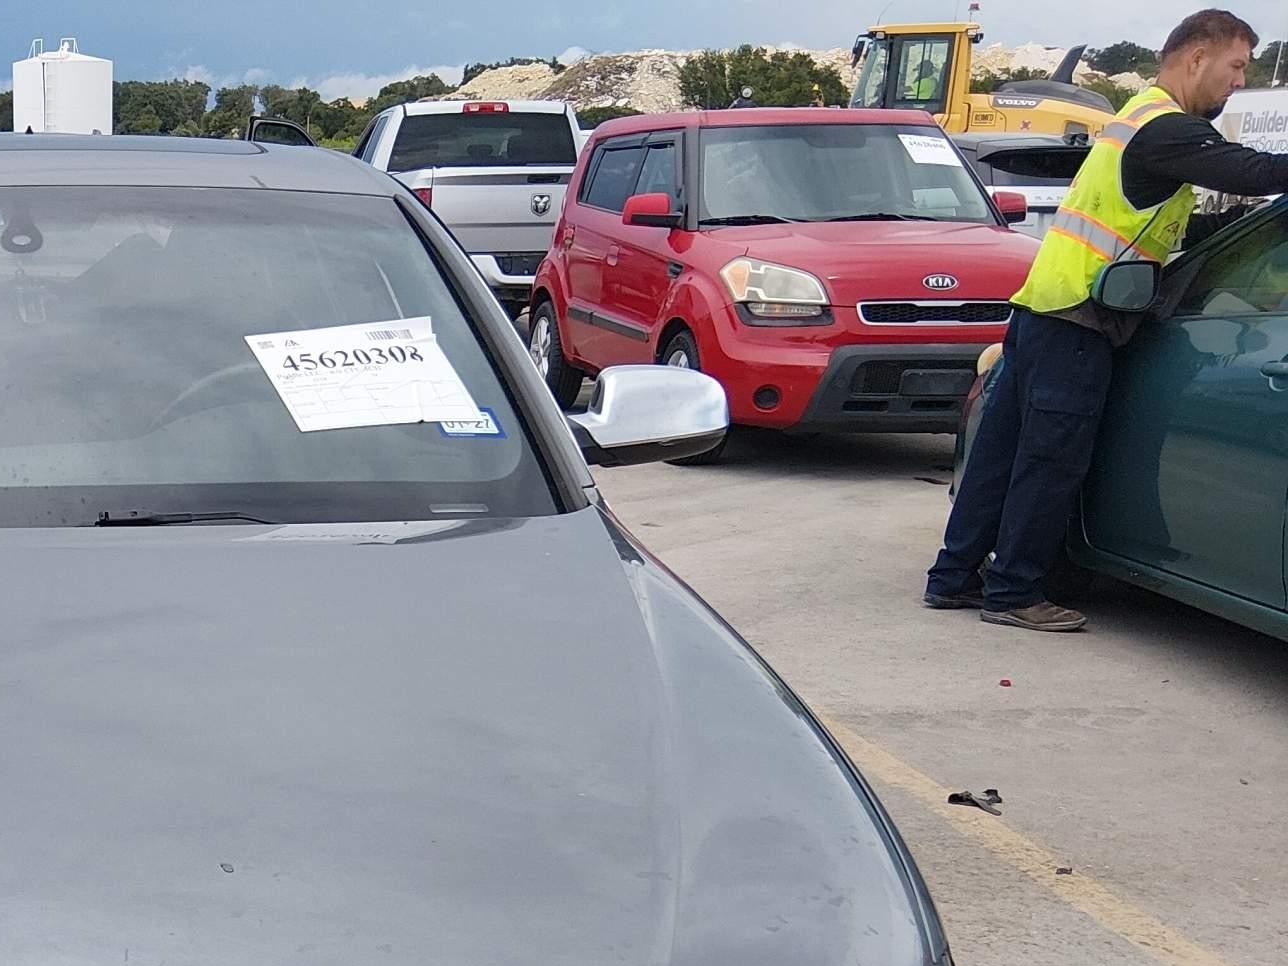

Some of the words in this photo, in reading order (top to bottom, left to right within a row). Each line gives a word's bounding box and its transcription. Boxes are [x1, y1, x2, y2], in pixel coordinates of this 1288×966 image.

[997, 98, 1037, 106] VOLVO
[928, 277, 953, 287] KIA
[282, 345, 424, 371] 45620308
